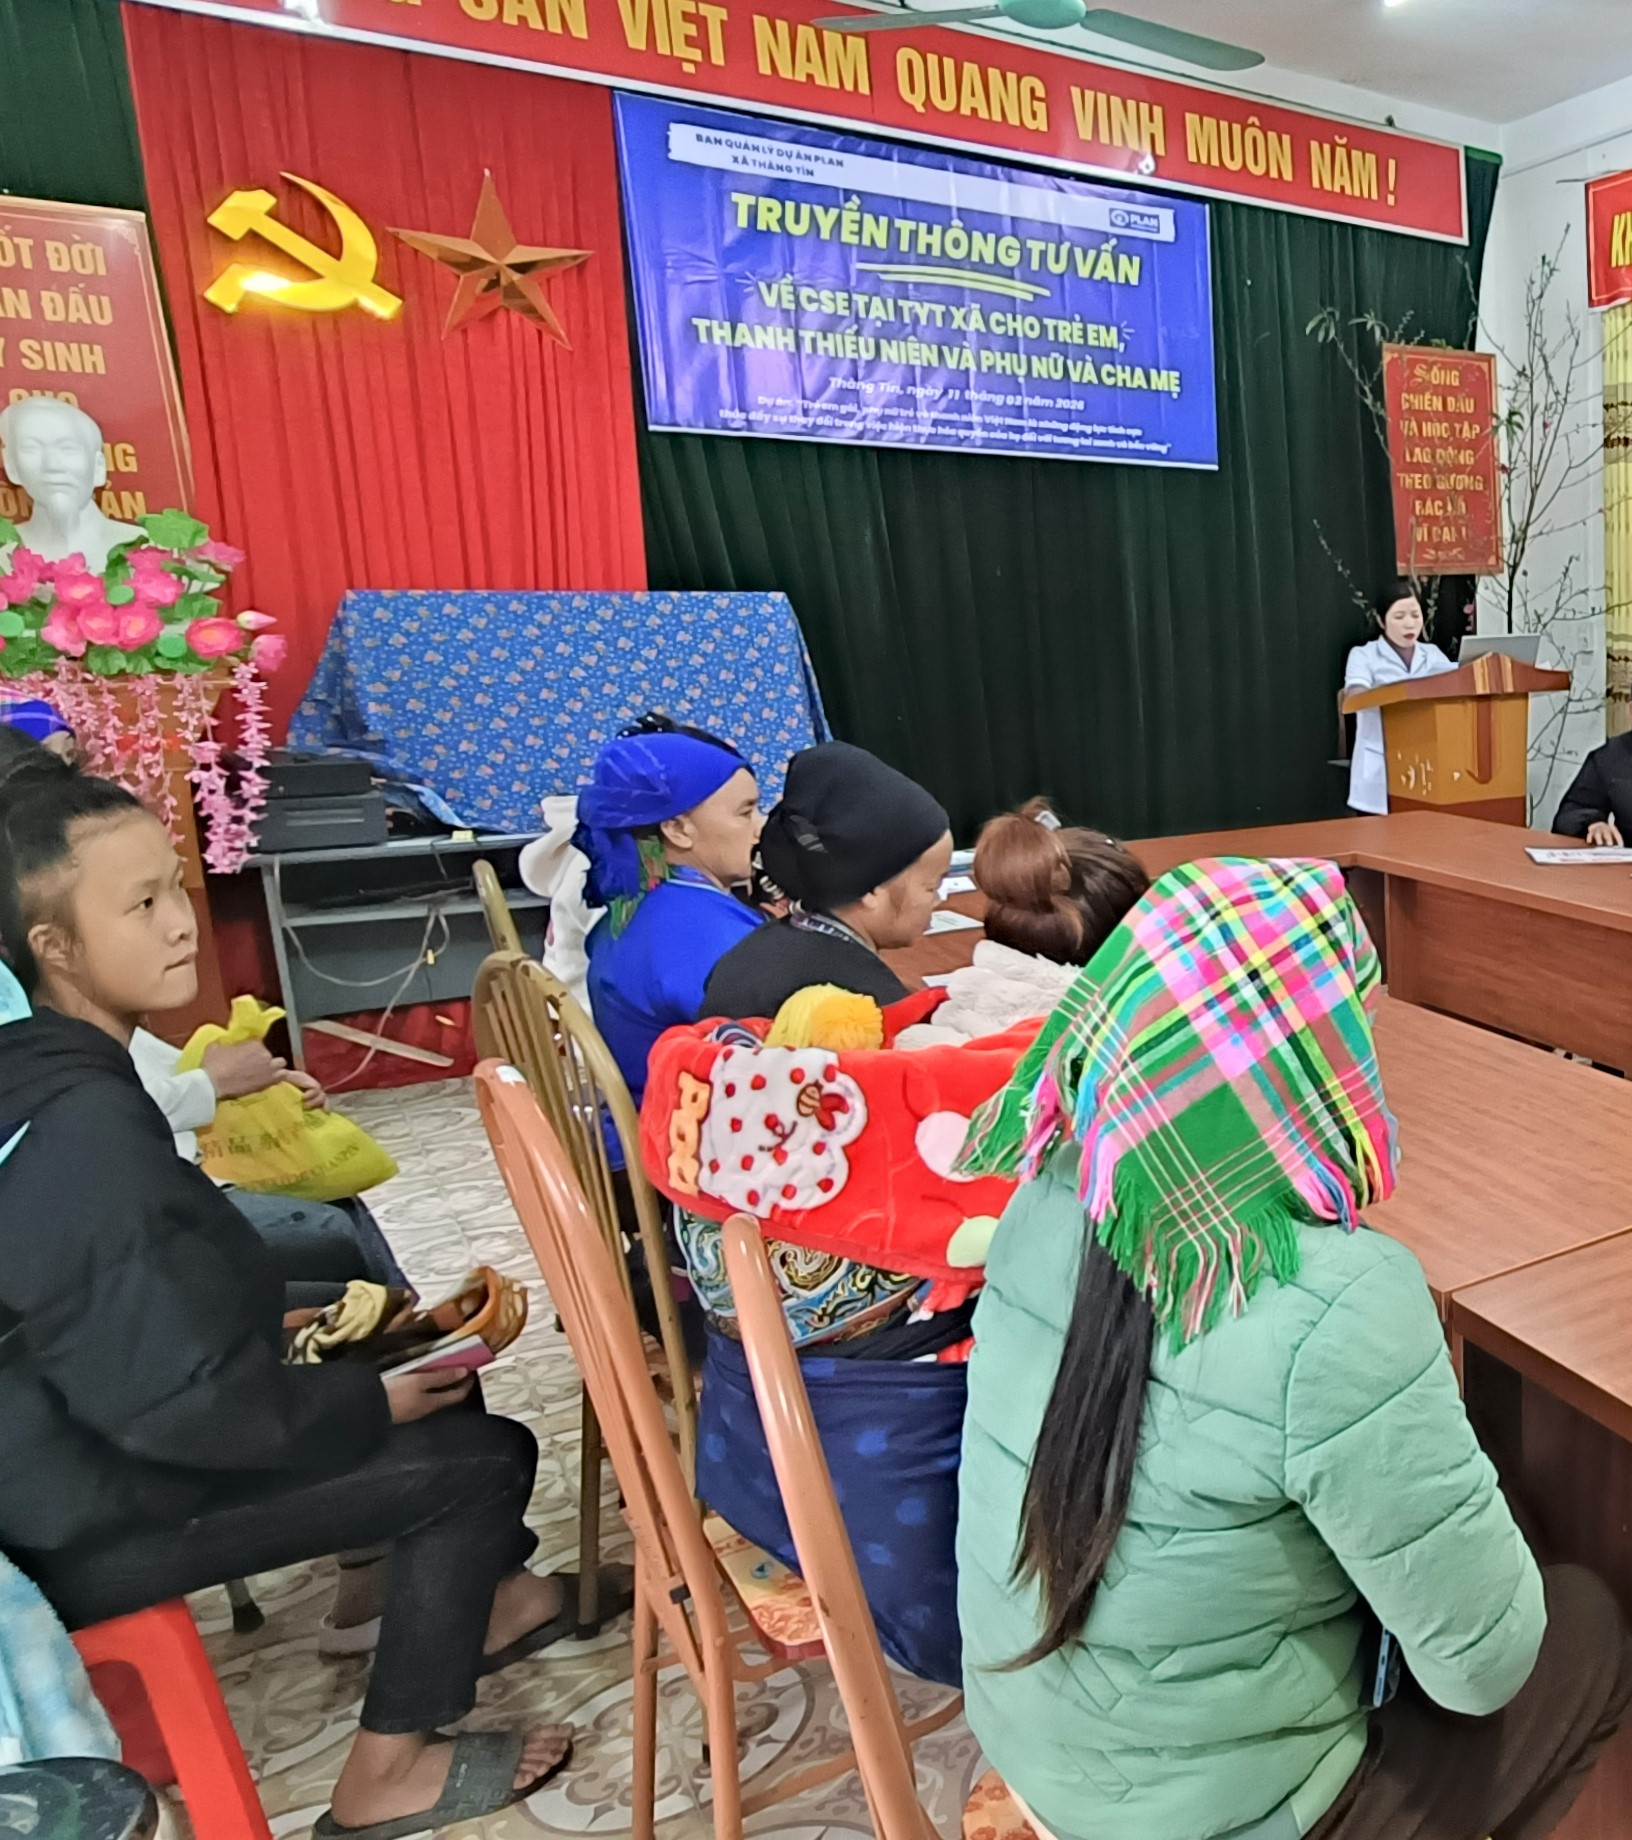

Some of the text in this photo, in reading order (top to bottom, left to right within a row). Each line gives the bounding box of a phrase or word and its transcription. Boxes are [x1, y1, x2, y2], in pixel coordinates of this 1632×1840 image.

[616, 0, 728, 74] VIỆT
[753, 14, 871, 96] NAM
[895, 46, 1048, 132] QUANG
[1071, 85, 1165, 157] VINH
[1185, 115, 1294, 183] MUÔN
[1310, 135, 1378, 201] NĂM
[1387, 158, 1396, 206] !
[696, 133, 722, 146] BAN
[814, 154, 844, 167] PLAN
[731, 194, 1141, 286] TRUYỀN THÔNG TƯ VẤN
[1130, 213, 1158, 228] PLAN
[45, 233, 107, 276] ĐỜI
[40, 282, 113, 326] ĐẤU
[757, 273, 1125, 352] VỀ CSE TẠI TYT XÃ CHO TRẺ EM,
[20, 339, 106, 374] SINH
[691, 318, 1181, 399] THANH THIẾU NIÊN VÀ PHỤ NỮ VÀ CHA MẸ
[907, 386, 942, 400] ngày
[947, 389, 960, 400] 11
[964, 390, 1004, 406] tháng
[1006, 394, 1022, 406] 02
[1023, 395, 1054, 408] năm
[1401, 393, 1443, 412] CHIẾN
